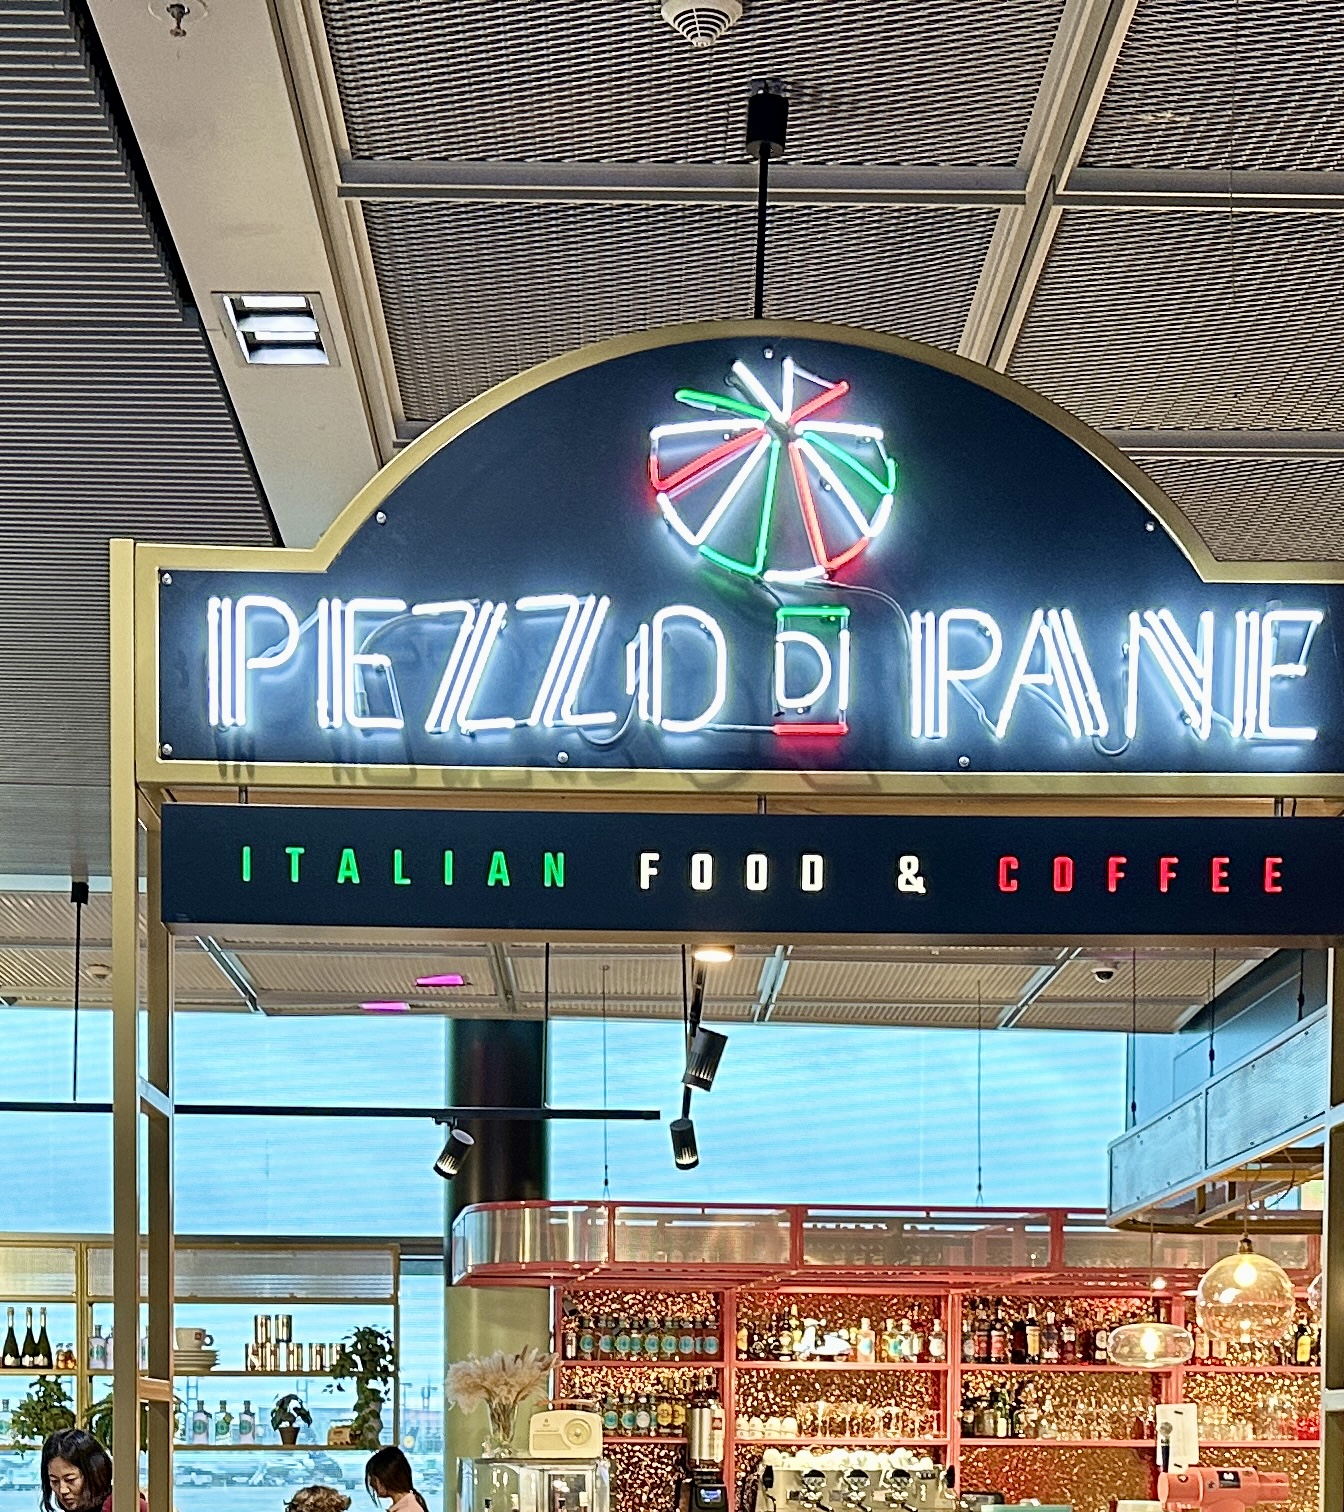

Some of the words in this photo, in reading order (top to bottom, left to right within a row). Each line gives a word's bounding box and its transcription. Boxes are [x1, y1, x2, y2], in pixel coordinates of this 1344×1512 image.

[206, 593, 728, 739] PEZZO
[773, 627, 851, 716] DI
[910, 607, 1325, 743] PANE
[241, 845, 567, 891] ITALIAN
[639, 850, 825, 894] FOOD
[896, 854, 927, 896] &
[998, 855, 1285, 895] COFFEE
